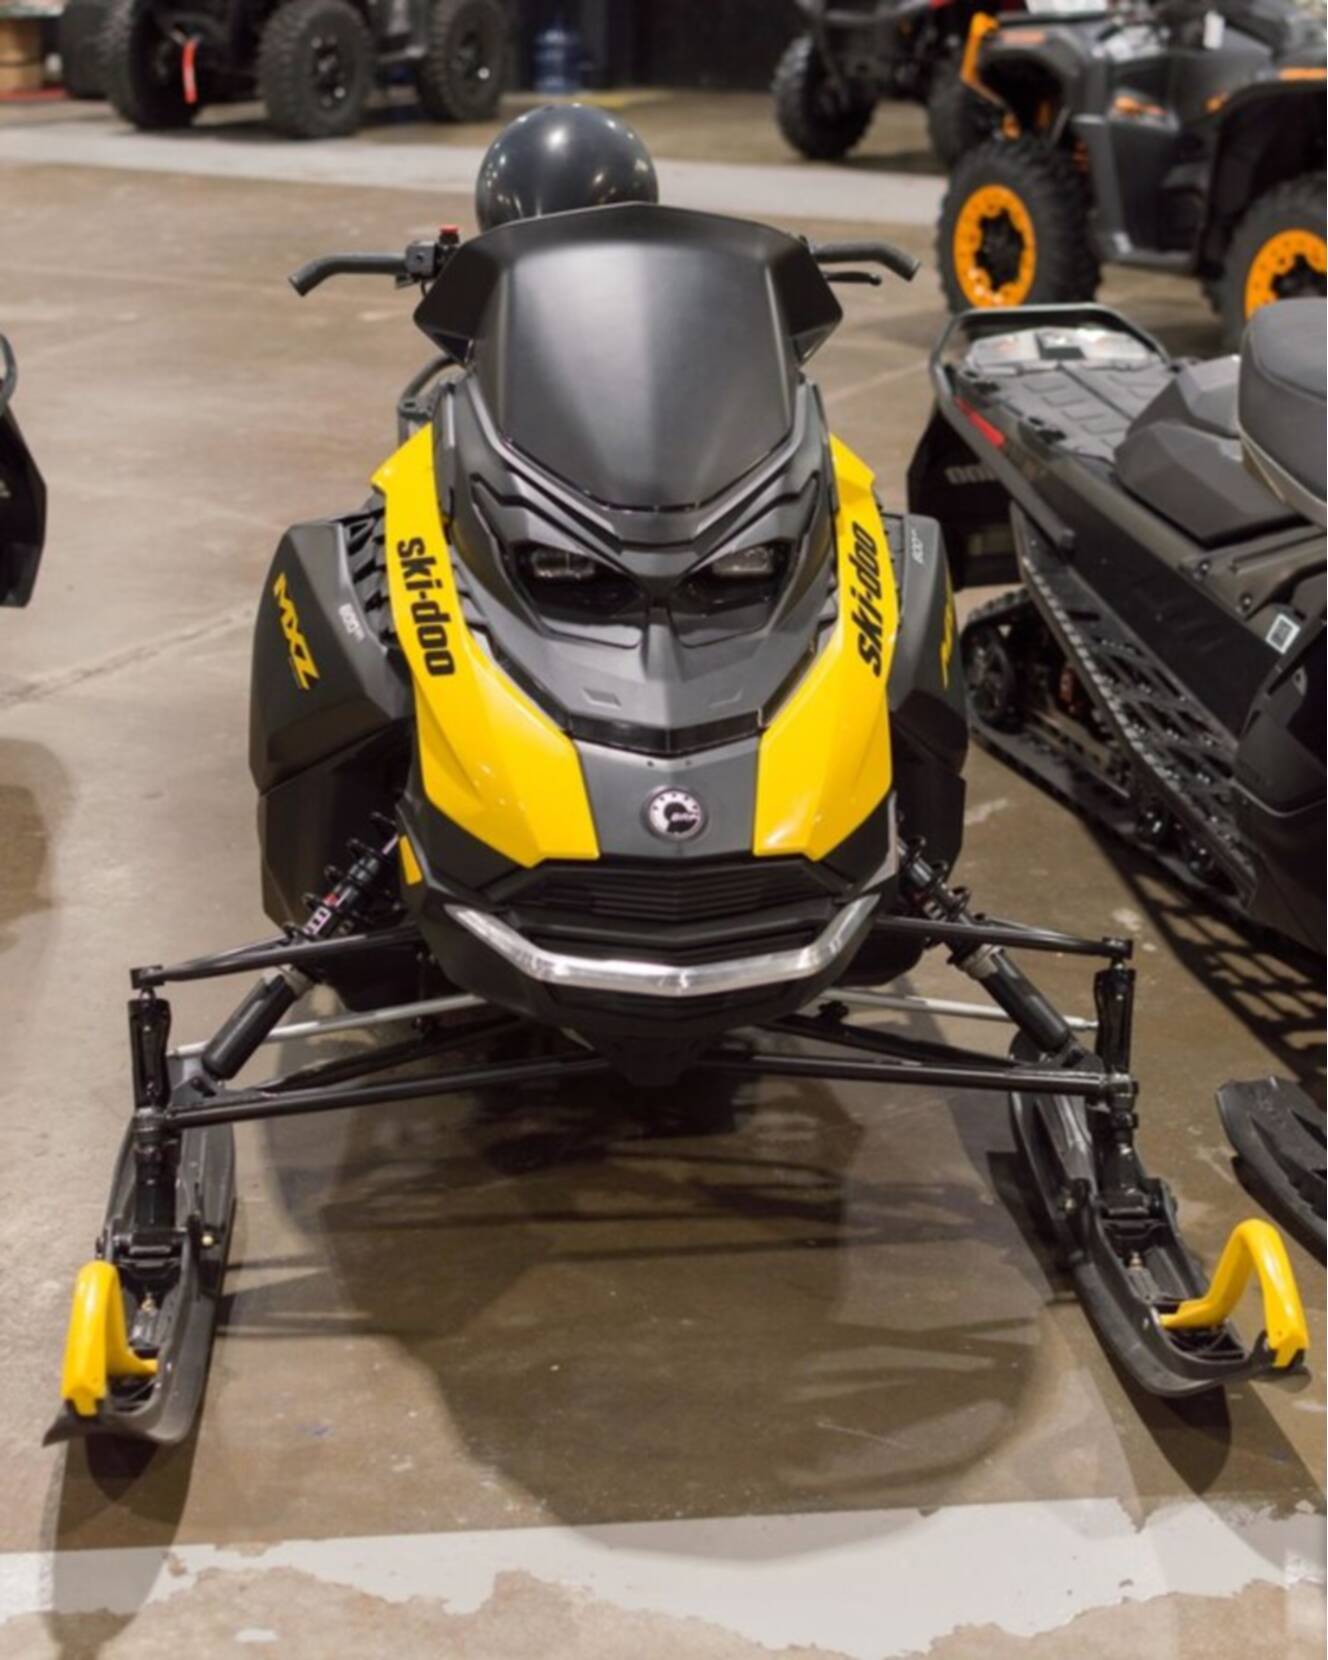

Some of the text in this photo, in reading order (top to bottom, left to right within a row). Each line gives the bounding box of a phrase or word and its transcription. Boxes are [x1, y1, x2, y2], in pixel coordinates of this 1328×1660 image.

[273, 572, 319, 689] MXZ
[397, 536, 455, 677] ski-doo
[848, 520, 883, 678] ski-doo
